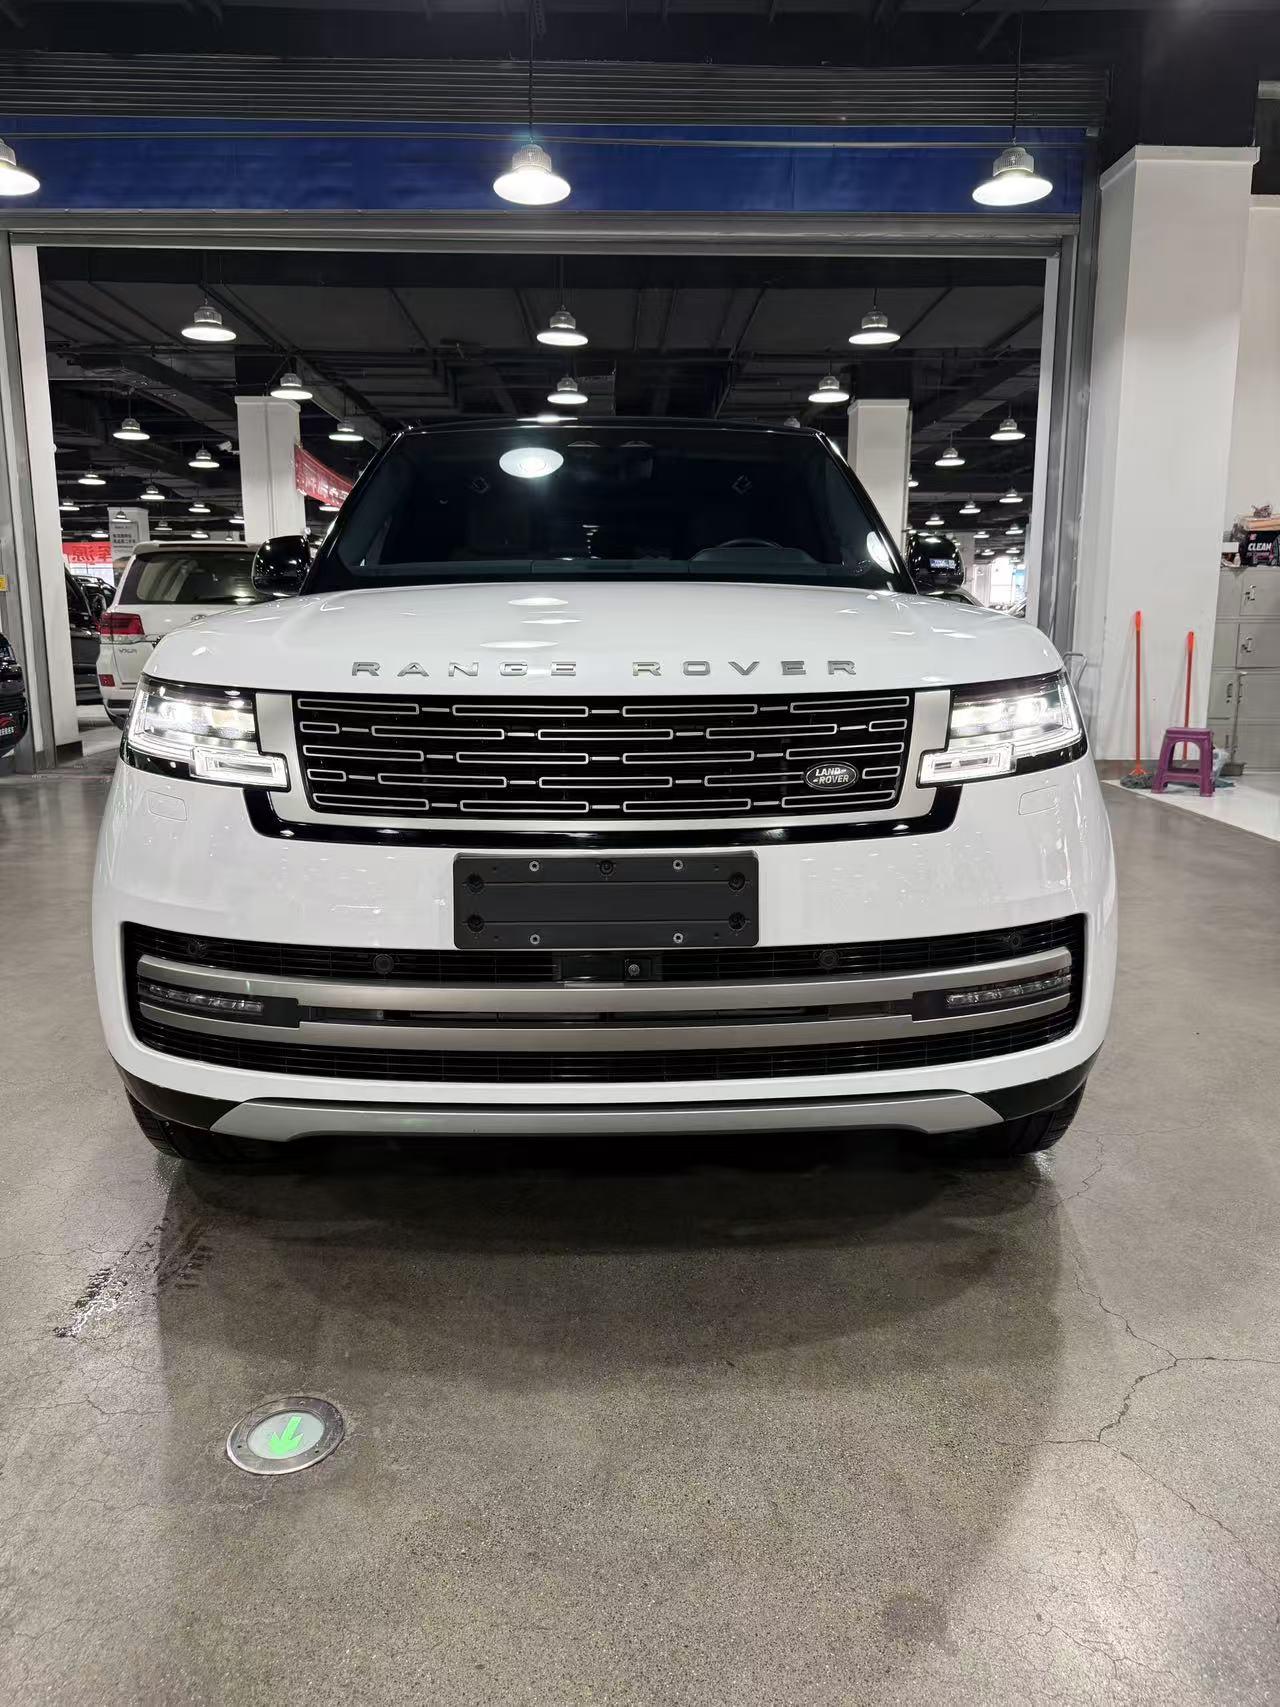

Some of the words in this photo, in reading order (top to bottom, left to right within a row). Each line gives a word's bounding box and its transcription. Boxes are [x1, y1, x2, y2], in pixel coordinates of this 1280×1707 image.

[1247, 542, 1272, 551] CLEAN
[351, 661, 577, 677] RANGE
[632, 660, 857, 676] ROVER
[815, 767, 841, 777] LAND
[818, 774, 850, 785] ROVER
